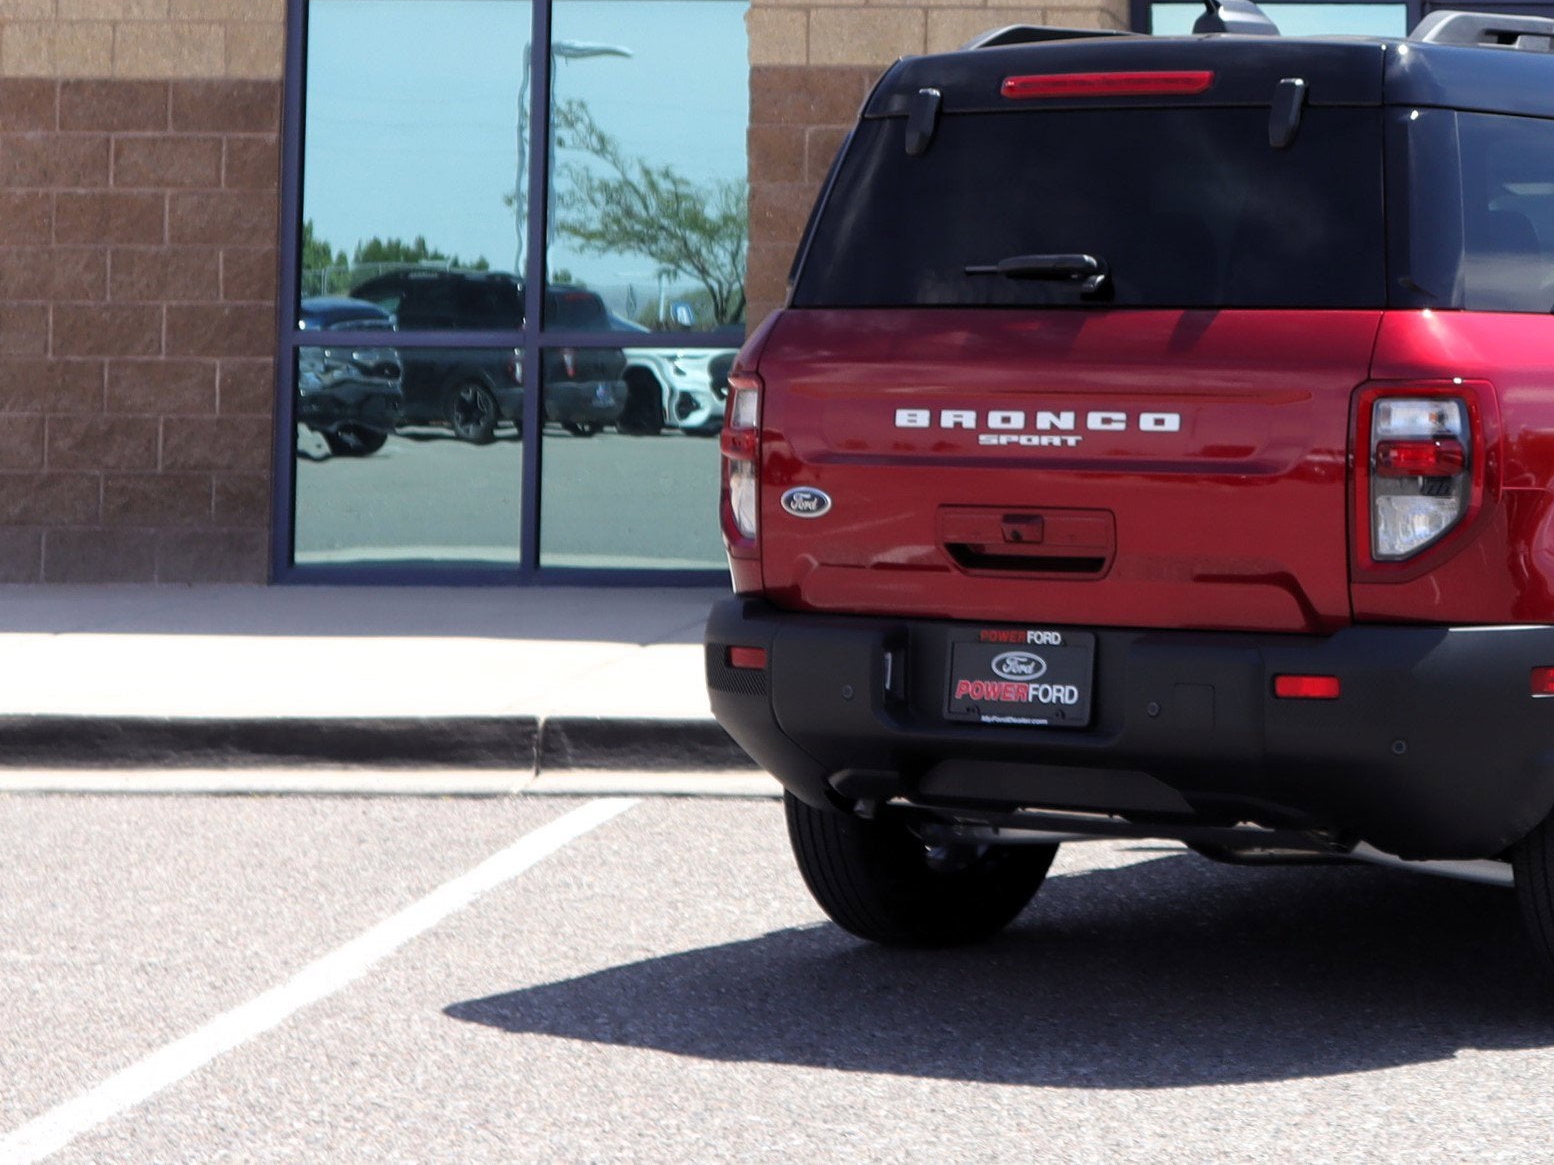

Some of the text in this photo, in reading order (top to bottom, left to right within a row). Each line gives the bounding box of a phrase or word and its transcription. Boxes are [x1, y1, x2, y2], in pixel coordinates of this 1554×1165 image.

[895, 408, 1181, 432] BRONCO
[978, 434, 1083, 447] SPORT
[790, 492, 818, 511] Ford
[980, 630, 1062, 645] POWERFORD
[1002, 656, 1036, 675] Ford
[955, 680, 1079, 704] POWERFORD
